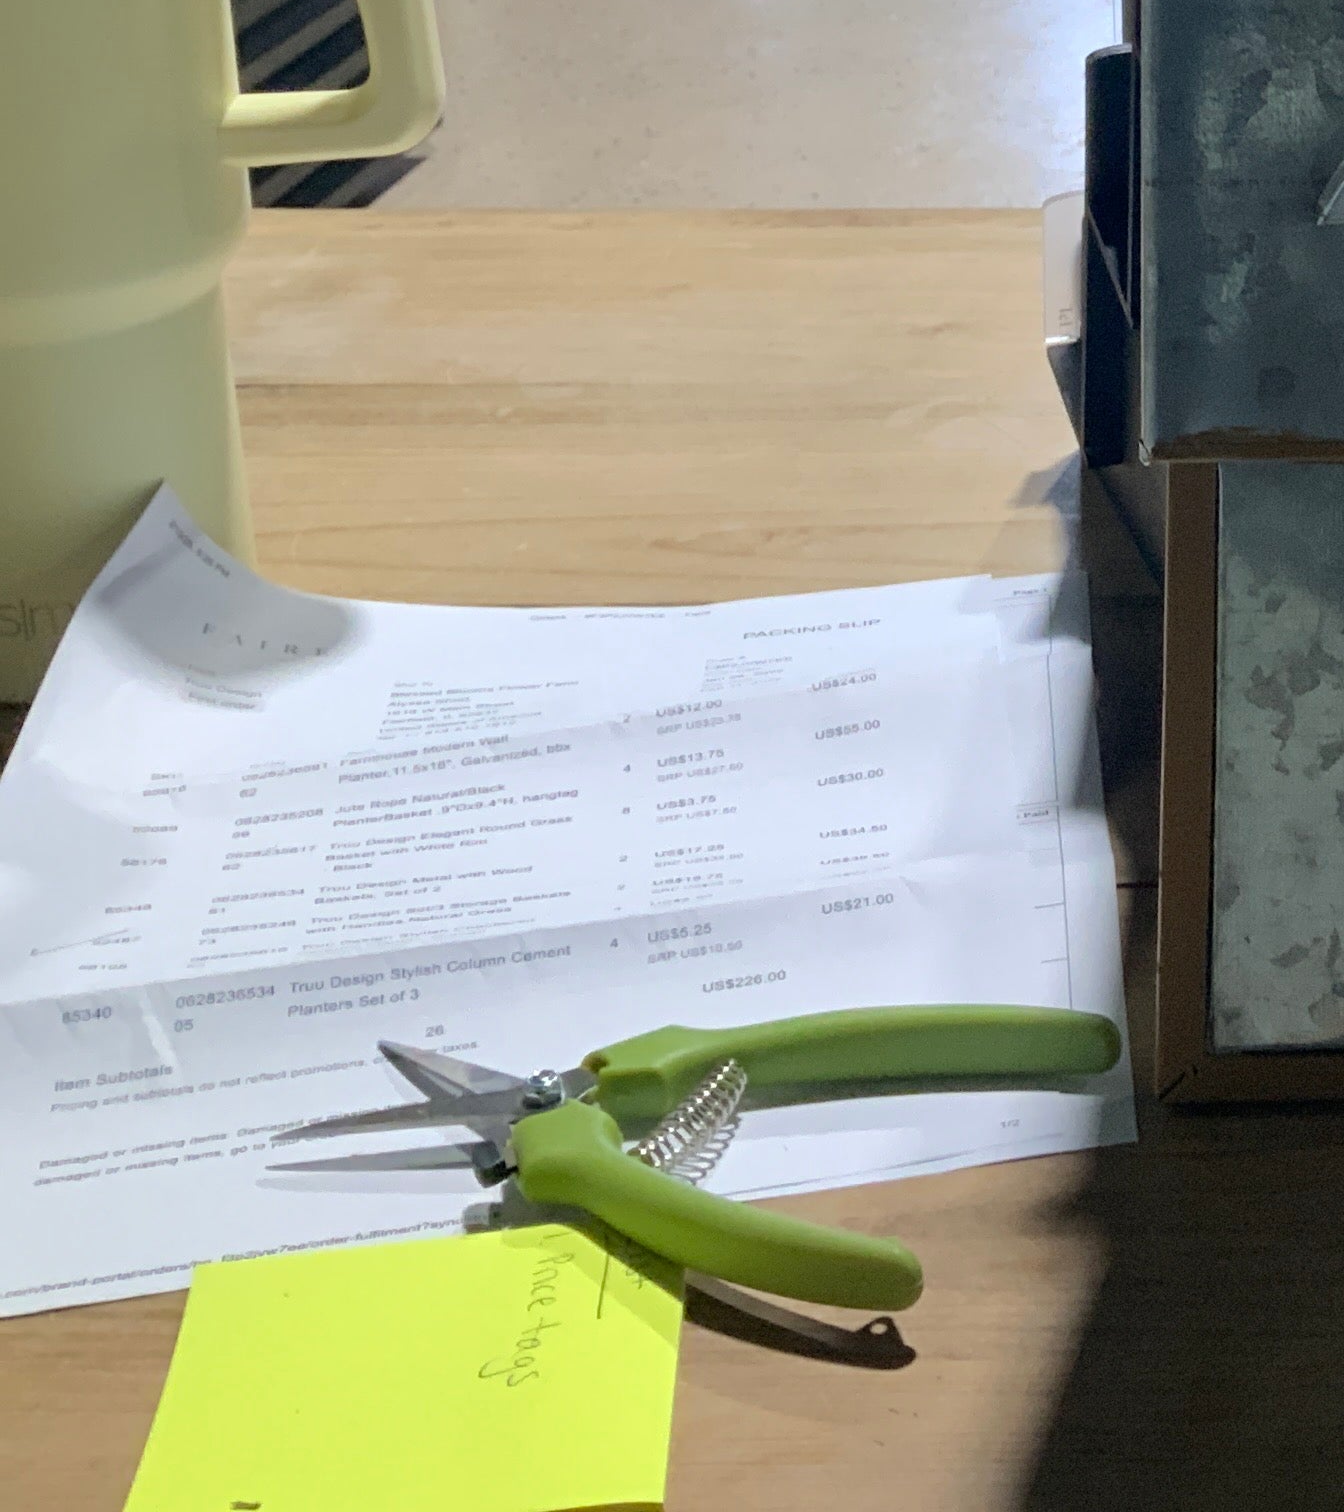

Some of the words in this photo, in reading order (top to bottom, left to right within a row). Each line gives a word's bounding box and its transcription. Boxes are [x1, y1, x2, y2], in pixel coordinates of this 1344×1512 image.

[743, 623, 832, 640] PACKING
[838, 618, 882, 630] SLIP
[814, 718, 882, 741] US$55.00
[816, 767, 885, 788] US$30.00
[820, 892, 896, 916] US$21.00
[647, 922, 713, 944] US$5.25
[330, 970, 385, 990] Design
[389, 962, 442, 982] Stylish
[446, 953, 507, 974] Column
[510, 944, 573, 965] Cement
[702, 968, 788, 994] US$226.00
[172, 1017, 195, 1034] 05
[286, 997, 354, 1019] Planters
[358, 992, 386, 1008] Set
[389, 988, 406, 1004] of
[424, 1023, 445, 1039] 26
[95, 1063, 174, 1088] Subtotals
[101, 1094, 130, 1107] and
[219, 1074, 241, 1088] not
[39, 1150, 109, 1171] Damaged
